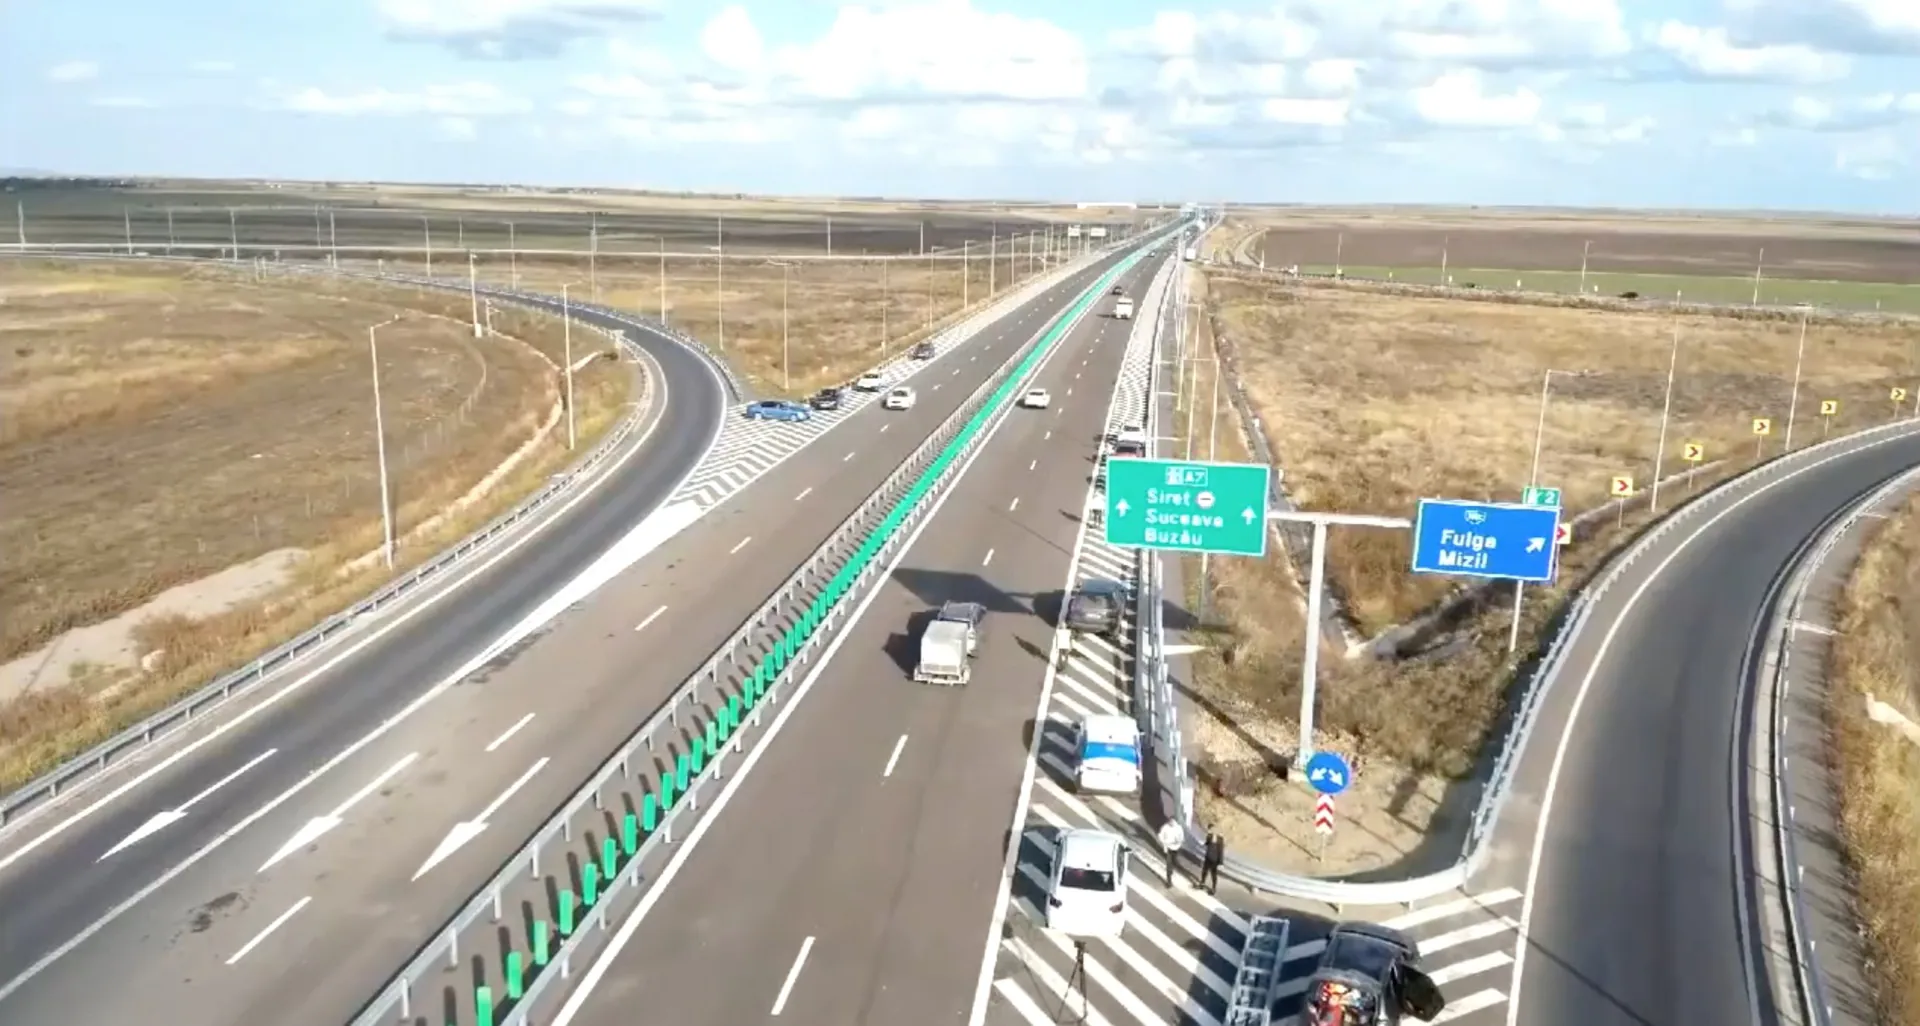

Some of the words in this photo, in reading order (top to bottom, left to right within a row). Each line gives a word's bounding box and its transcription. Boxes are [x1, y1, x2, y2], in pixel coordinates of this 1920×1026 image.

[1147, 488, 1191, 506] Siret
[1545, 492, 1555, 504] 2
[1145, 508, 1224, 527] Suceava
[1440, 529, 1497, 551] Fulga
[1438, 549, 1488, 569] Mizil
